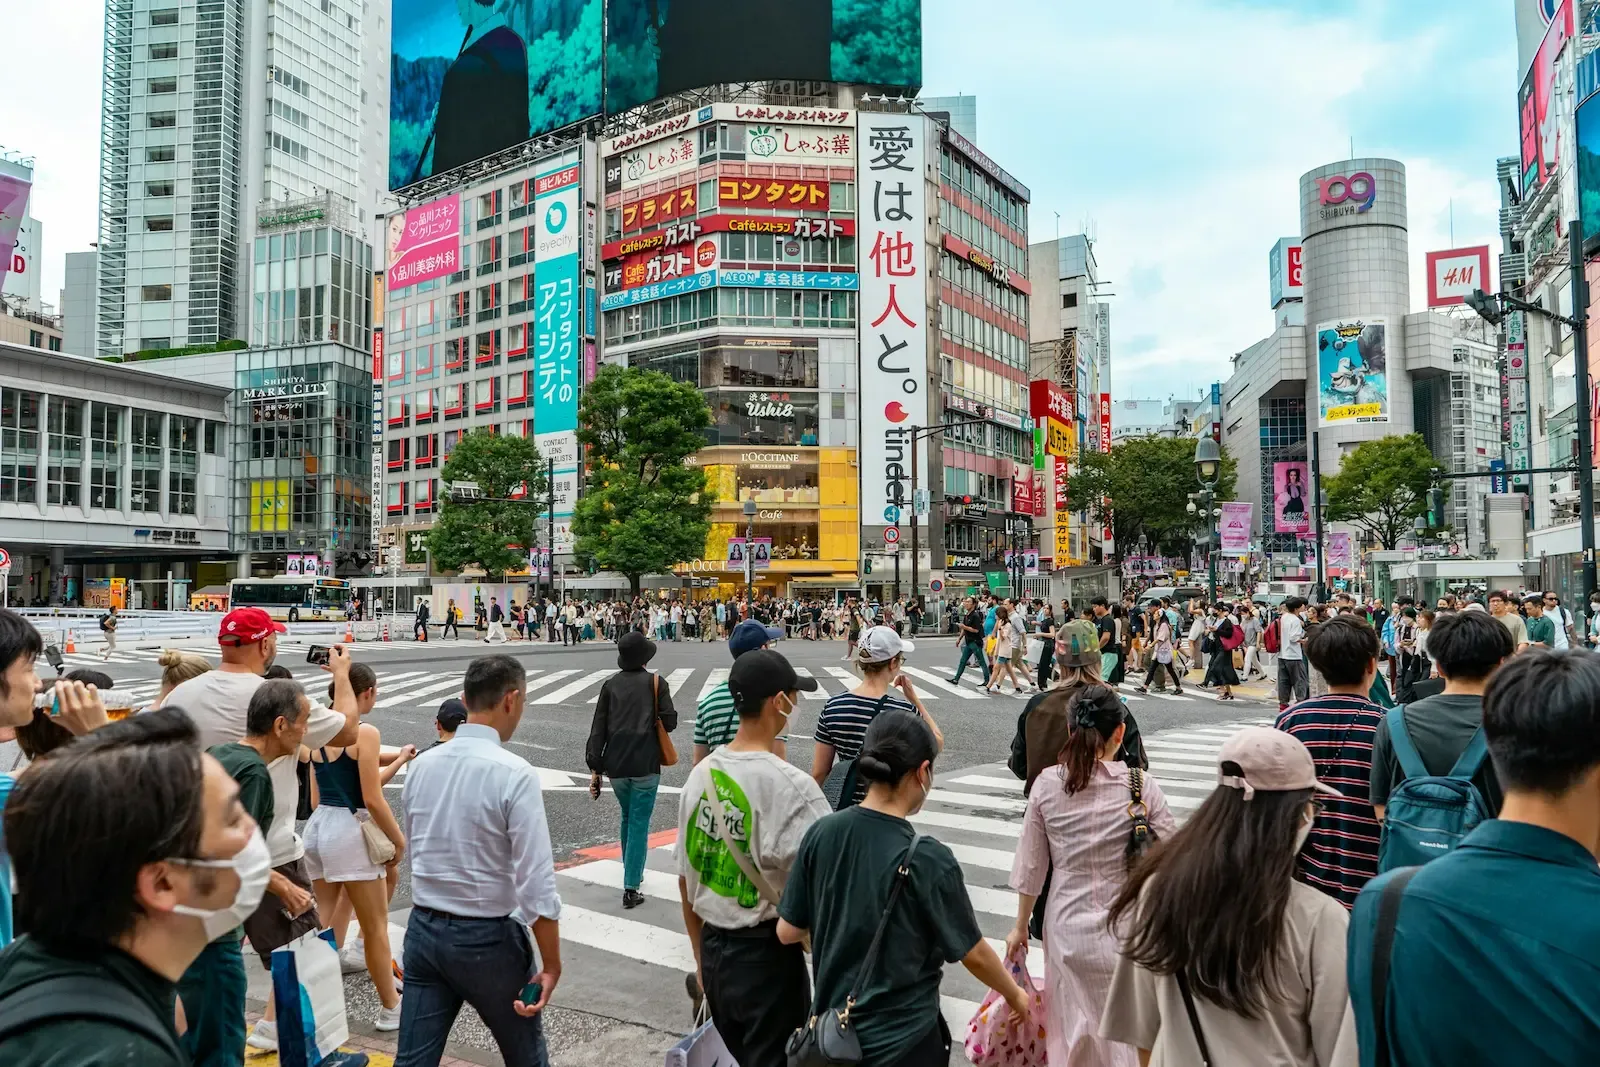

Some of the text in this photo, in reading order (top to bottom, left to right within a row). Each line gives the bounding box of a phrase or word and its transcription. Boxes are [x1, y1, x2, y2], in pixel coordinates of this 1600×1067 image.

[735, 105, 849, 124] しゃぶしゃぶバイキング
[612, 114, 691, 152] しゃぶしゃぶバイキング
[784, 132, 850, 155] しゃぶ葉
[648, 139, 694, 171] しゃぶ葉
[539, 170, 575, 191] 当ビル5F
[607, 167, 621, 182] 9F
[719, 181, 826, 205] コンタクト
[1314, 171, 1376, 213] 109
[418, 203, 456, 226] 品川スキン
[623, 189, 696, 227] プライス
[1320, 205, 1355, 219] SHIBUYA
[419, 218, 452, 240] クリニック
[665, 221, 702, 248] ガスト
[794, 218, 843, 238] ガスト
[540, 234, 573, 252] eyecity
[397, 249, 456, 282] 品川美容外科
[646, 252, 691, 283] ガスト
[699, 252, 715, 261] ガスト
[869, 126, 917, 394] 愛は他人と。
[605, 269, 622, 287] 7F
[625, 263, 645, 278] Café
[723, 272, 856, 287] AEON 英会話イーオン
[1443, 265, 1474, 287] H&M
[631, 277, 696, 302] 英会話イーオン
[539, 282, 558, 405] アイシティ
[559, 277, 573, 403] コンタクトの
[243, 382, 330, 399] MARK CITY
[264, 376, 305, 386] SHIBUYA
[1023, 418, 1033, 432] 4F
[543, 437, 568, 448] CONTACT
[548, 447, 563, 455] LENS
[741, 451, 800, 462] L'OCCITANE
[885, 427, 910, 509] tinder
[759, 509, 783, 521] Café
[1057, 513, 1067, 555] 処方せん
